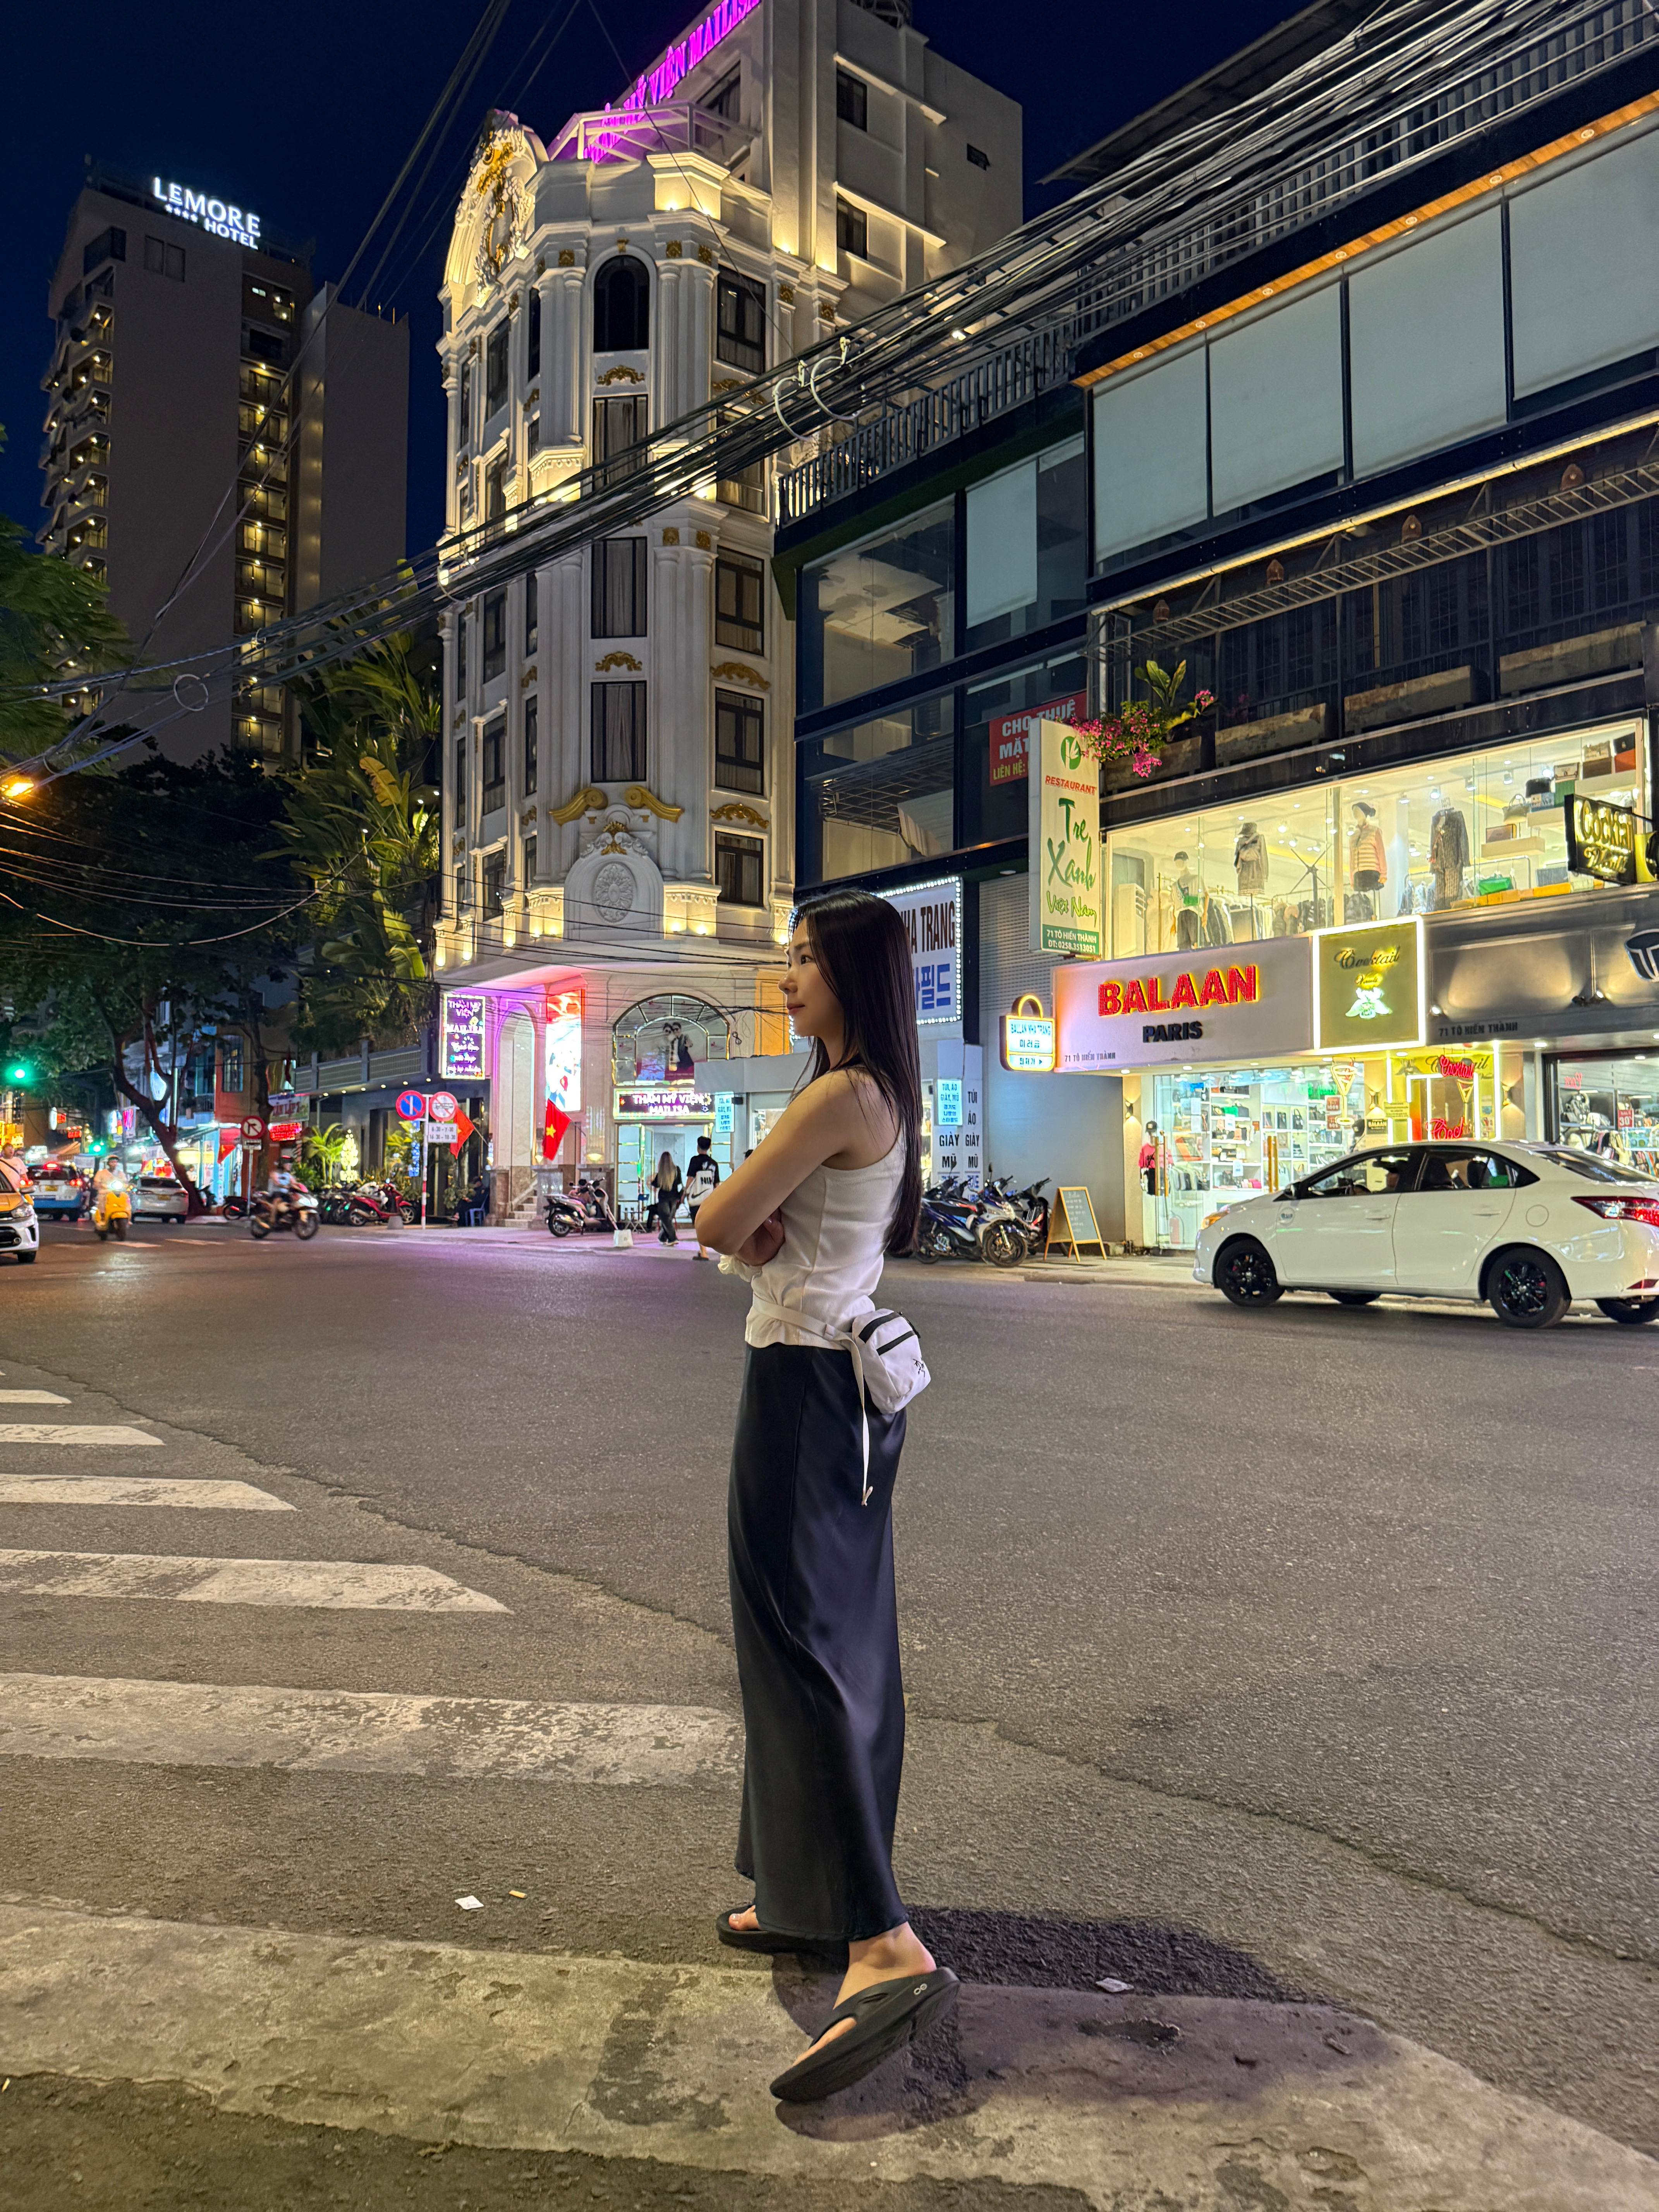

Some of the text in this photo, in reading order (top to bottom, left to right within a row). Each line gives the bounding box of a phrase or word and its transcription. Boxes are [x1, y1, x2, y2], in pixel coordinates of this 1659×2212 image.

[649, 41, 687, 105] VIỆN
[153, 176, 261, 237] LEMORE
[204, 217, 258, 250] HOTEL
[1002, 715, 1030, 737] CHO
[993, 759, 1025, 780] LIÊN HỆ:
[1045, 775, 1096, 795] RESTAURANT
[1058, 798, 1089, 844] Tre
[1047, 836, 1096, 891] Xanh
[1071, 895, 1097, 927] Nam
[901, 900, 955, 954] HA TRANG
[1047, 929, 1096, 944] 71 TÔ HIẾN THÀNH
[1048, 939, 1096, 953] ĐT: 0258.3513051
[1334, 945, 1401, 970] Cocktail
[1097, 965, 1259, 1017] BALAAN
[1142, 1021, 1203, 1043] PARIS
[1438, 1028, 1448, 1037] 71
[1451, 1025, 1462, 1036] TÔ
[1073, 1053, 1080, 1062] TÔ
[1440, 1055, 1474, 1079] Cocktail
[967, 1089, 977, 1104] TÚI
[967, 1110, 976, 1125] ÁO
[939, 1131, 959, 1147] GIÀY
[965, 1132, 979, 1147] GIÀY
[942, 1153, 957, 1168] MŨ
[968, 1154, 978, 1168] MŨ
